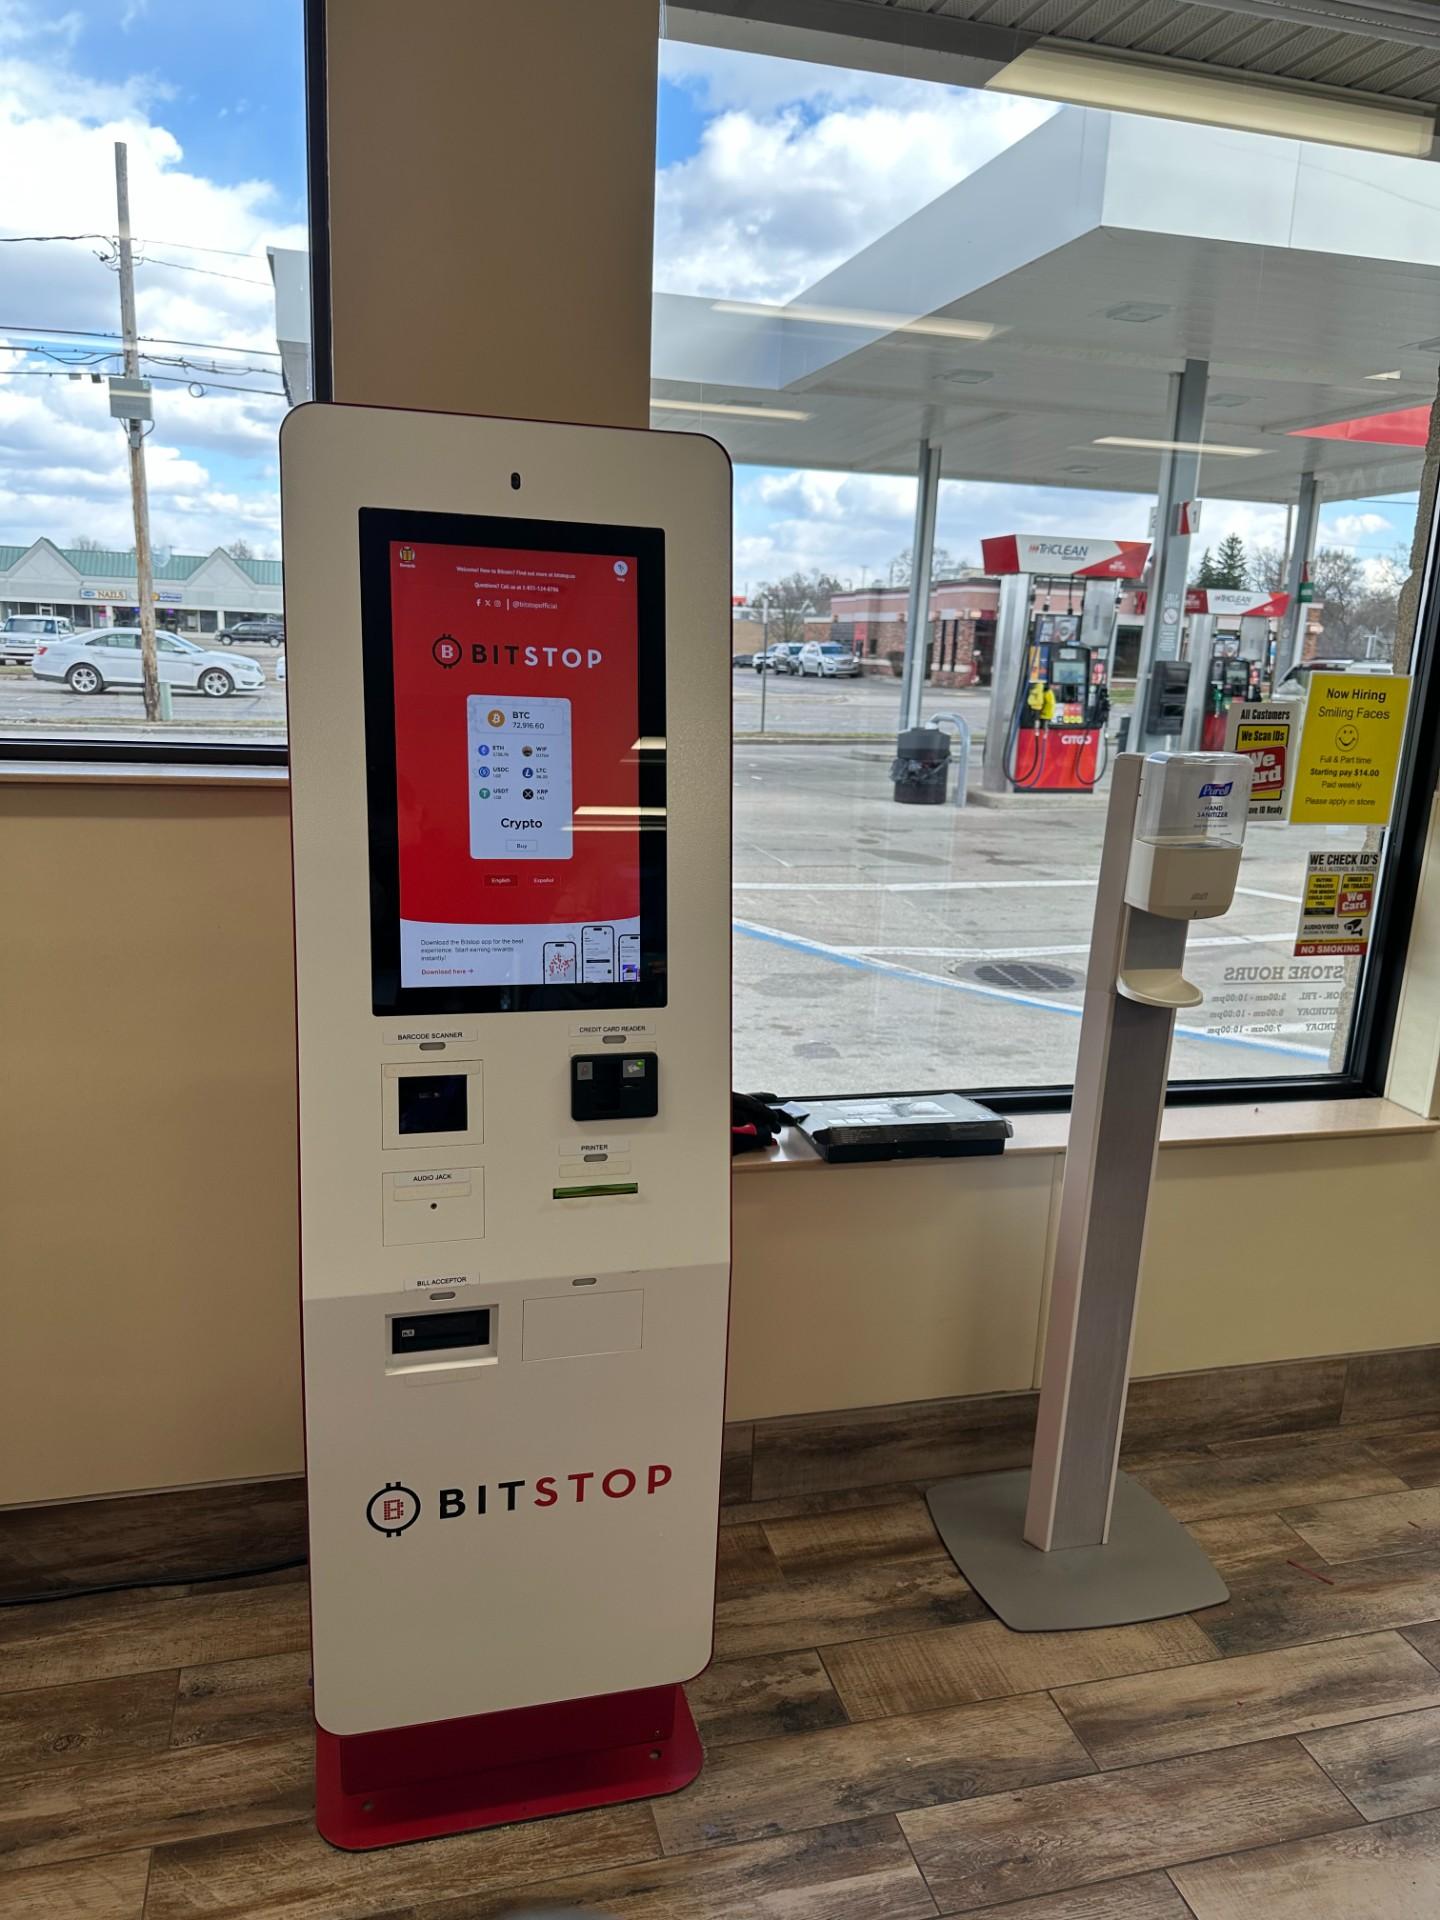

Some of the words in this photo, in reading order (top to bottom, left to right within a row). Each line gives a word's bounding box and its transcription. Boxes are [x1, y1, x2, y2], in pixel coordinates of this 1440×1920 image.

[1040, 543, 1089, 556] TriCLEAN
[472, 643, 602, 669] BITSTOP
[1326, 688, 1350, 699] Now
[1352, 689, 1387, 703] Hiring
[512, 711, 531, 719] BTC
[1240, 708, 1251, 720] All
[1252, 708, 1290, 720] Customers
[1318, 706, 1354, 720] Smiling
[1356, 707, 1390, 719] Faces
[1061, 735, 1092, 745] CITGO
[1241, 730, 1252, 741] We
[1253, 730, 1272, 741] Scan
[1272, 730, 1285, 741] IDs
[1320, 755, 1332, 763] Full
[1340, 755, 1355, 764] Part
[1356, 756, 1372, 764] time
[1251, 765, 1281, 784] ard
[1310, 768, 1338, 778] Starting
[1338, 770, 1353, 778] pay
[1353, 768, 1380, 777] $14.00
[1338, 781, 1362, 790] weekly
[1305, 796, 1328, 805] Please
[1328, 797, 1347, 806] apply
[1356, 797, 1376, 806] store
[1248, 806, 1258, 815] ave
[1259, 806, 1266, 815] ID
[1266, 806, 1283, 816] Ready
[501, 817, 543, 830] Crypto
[1310, 854, 1325, 865] WE
[1326, 854, 1358, 865] CHECK
[1360, 854, 1379, 865] ID'S
[1347, 892, 1363, 902] We
[1342, 901, 1367, 911] Card
[1301, 945, 1315, 954] NO
[1316, 944, 1361, 954] SMOKING
[413, 1174, 433, 1182] AUDIO
[417, 1279, 430, 1287] BILL
[431, 1276, 467, 1285] ACCEPTOR
[439, 1464, 672, 1520] BITSTOP
